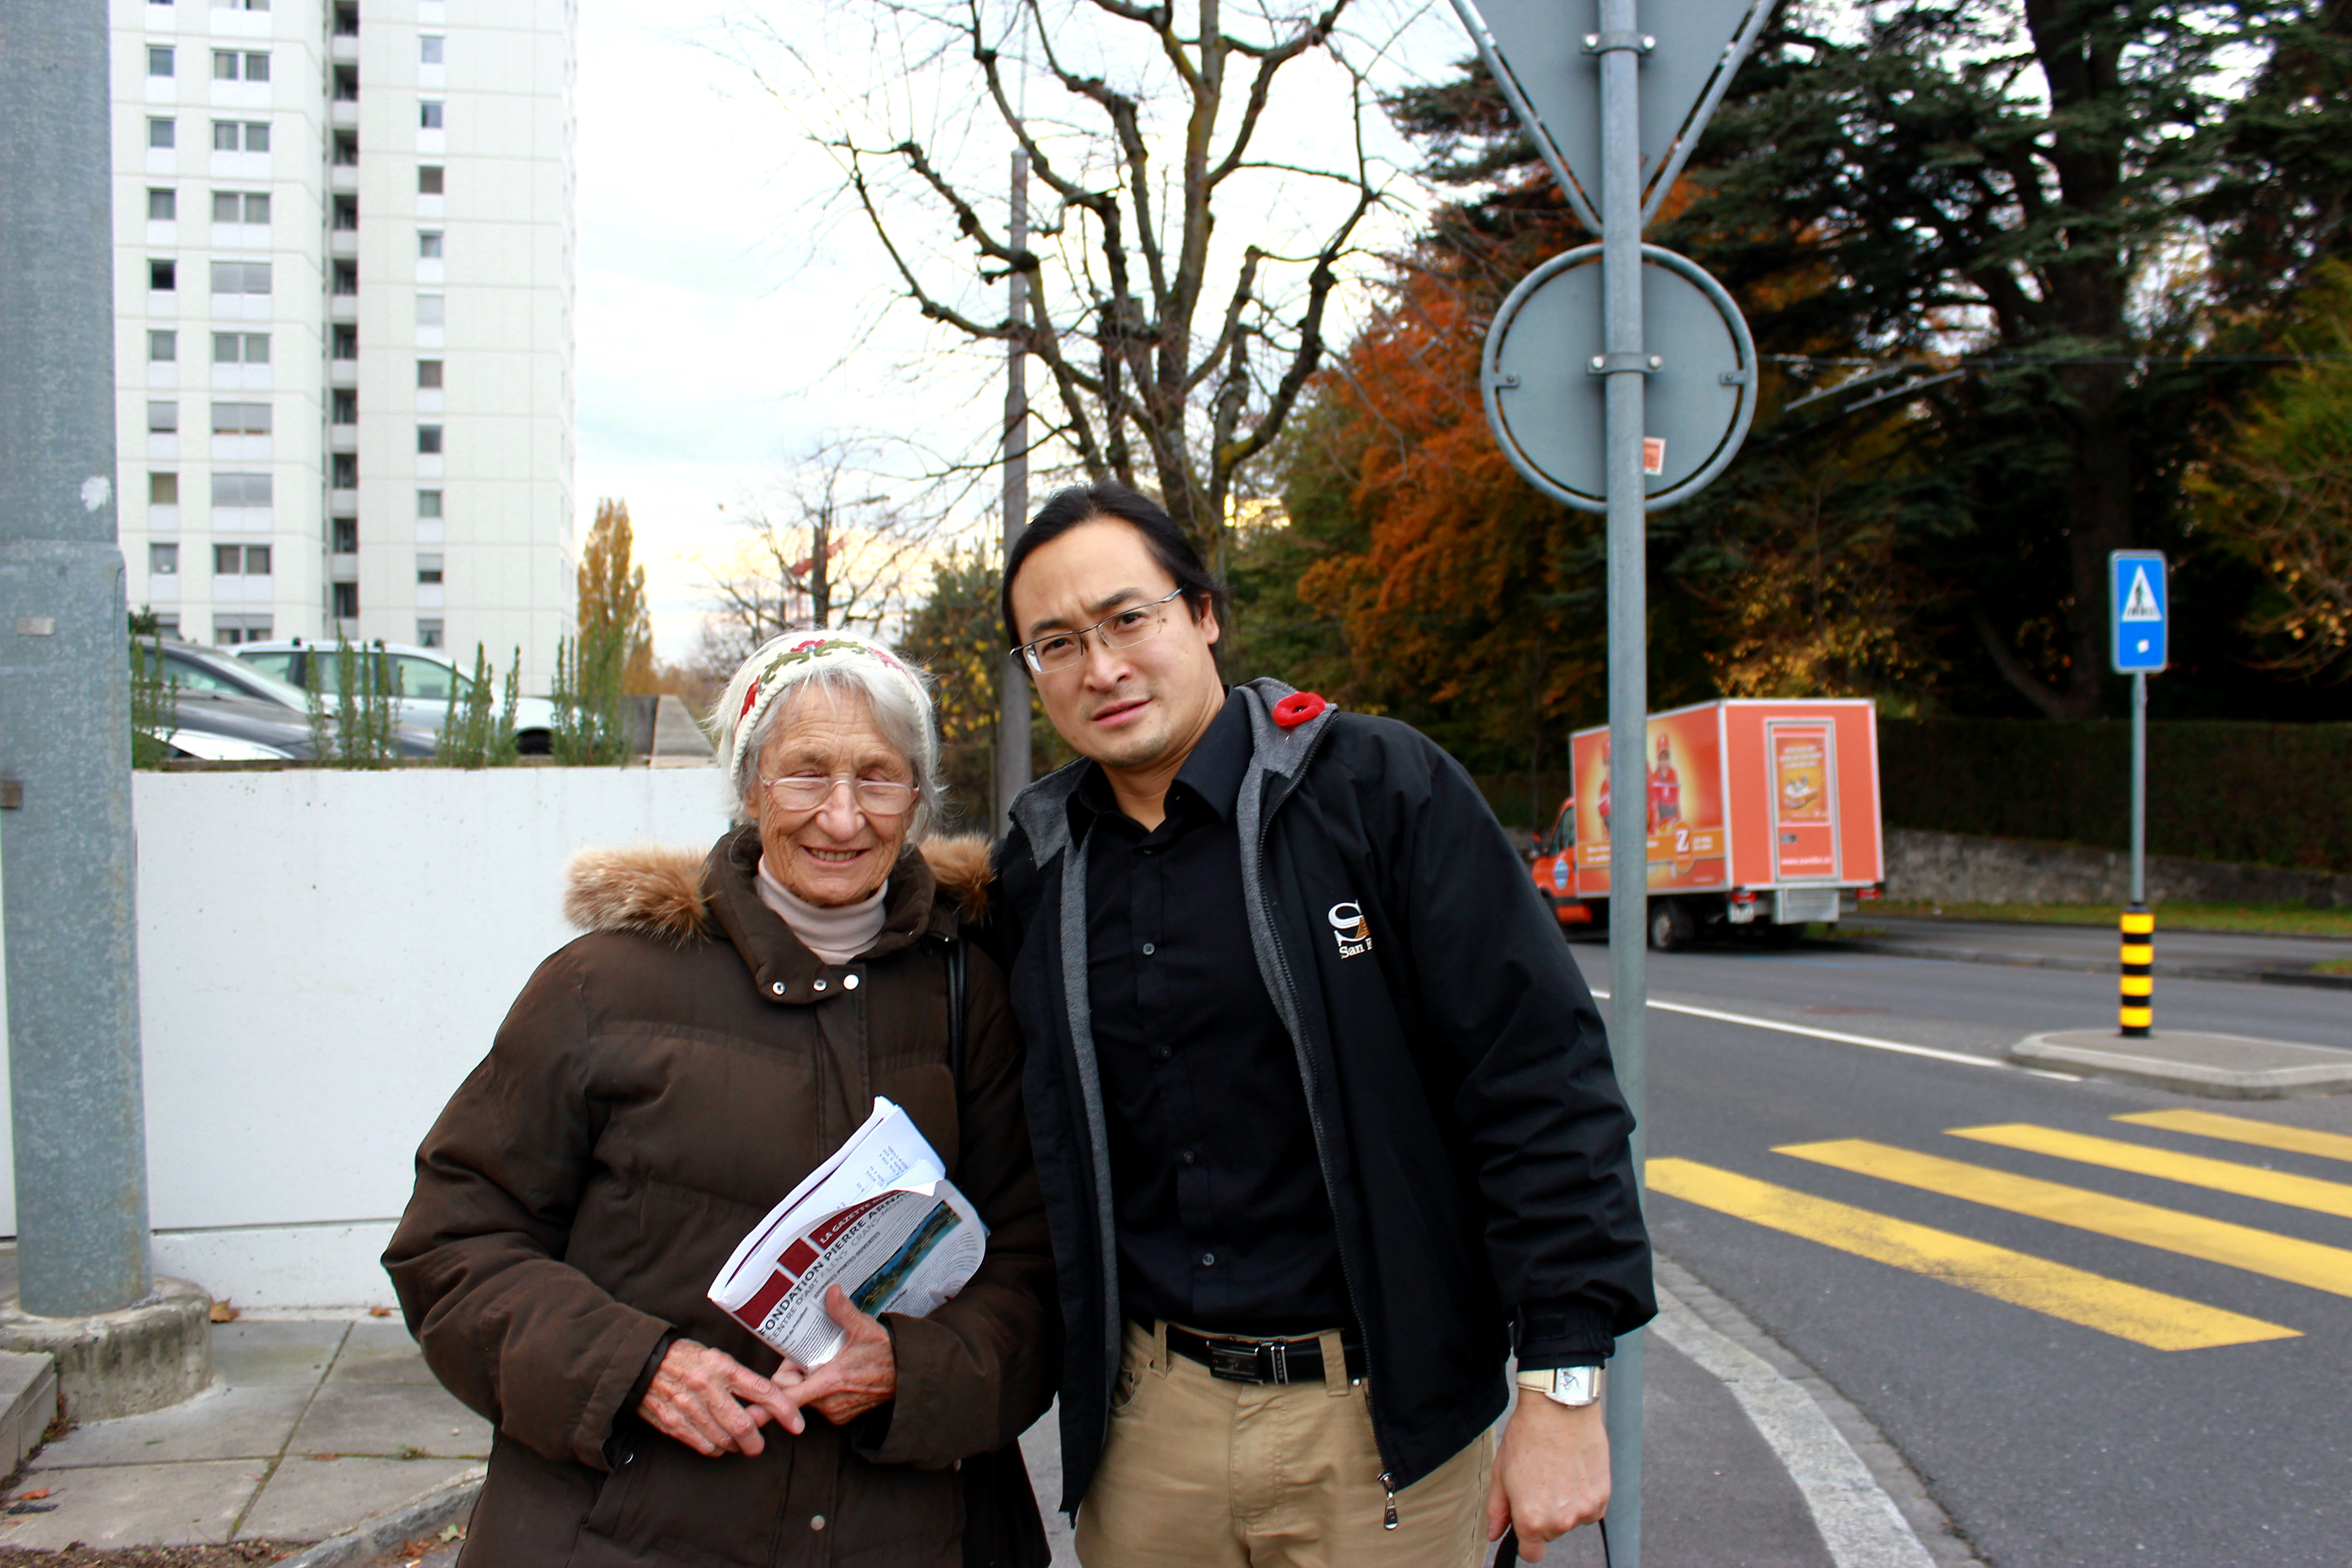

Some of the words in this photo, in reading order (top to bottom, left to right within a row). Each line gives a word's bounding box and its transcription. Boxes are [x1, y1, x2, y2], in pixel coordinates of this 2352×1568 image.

[1338, 943, 1365, 960] San
[819, 1231, 833, 1244] LA
[832, 1203, 872, 1233] GAZETTE
[757, 1261, 824, 1337] FONDATION
[823, 1219, 867, 1262] PIERRE
[868, 1191, 909, 1220] ARNA
[766, 1306, 798, 1342] CENTRE
[826, 1250, 848, 1271] LENS
